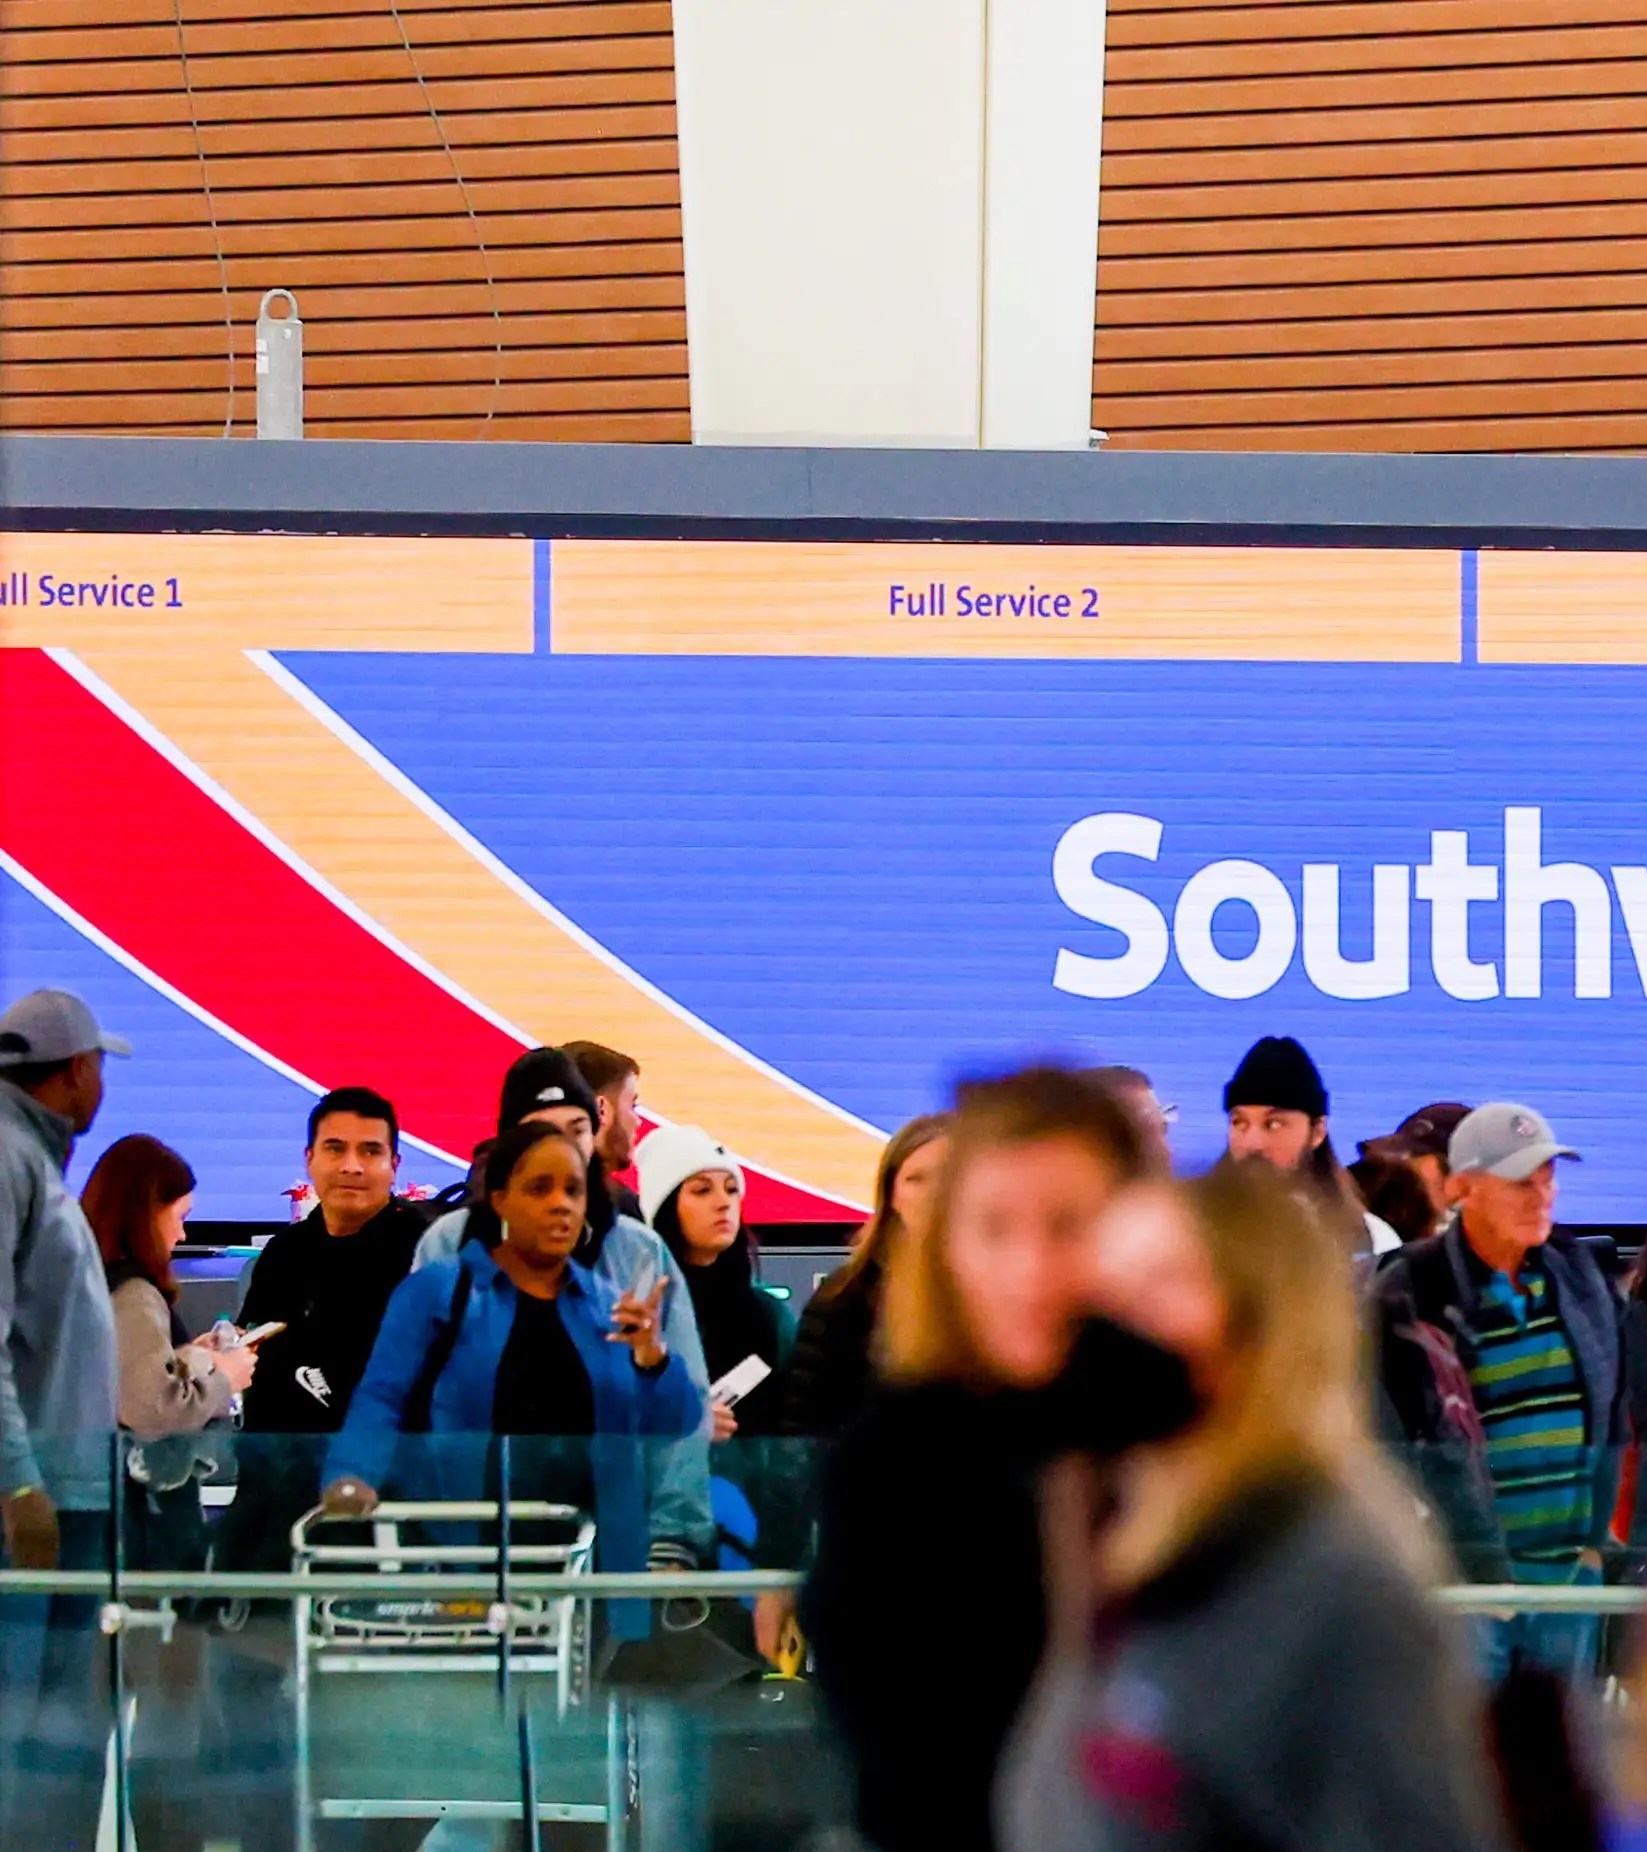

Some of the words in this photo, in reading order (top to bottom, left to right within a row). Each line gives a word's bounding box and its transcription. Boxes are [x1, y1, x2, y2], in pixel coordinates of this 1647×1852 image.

[38, 574, 155, 608] Service
[165, 578, 183, 608] 1
[889, 583, 945, 617] Full
[956, 584, 1071, 618] Service
[1081, 588, 1099, 618] 2
